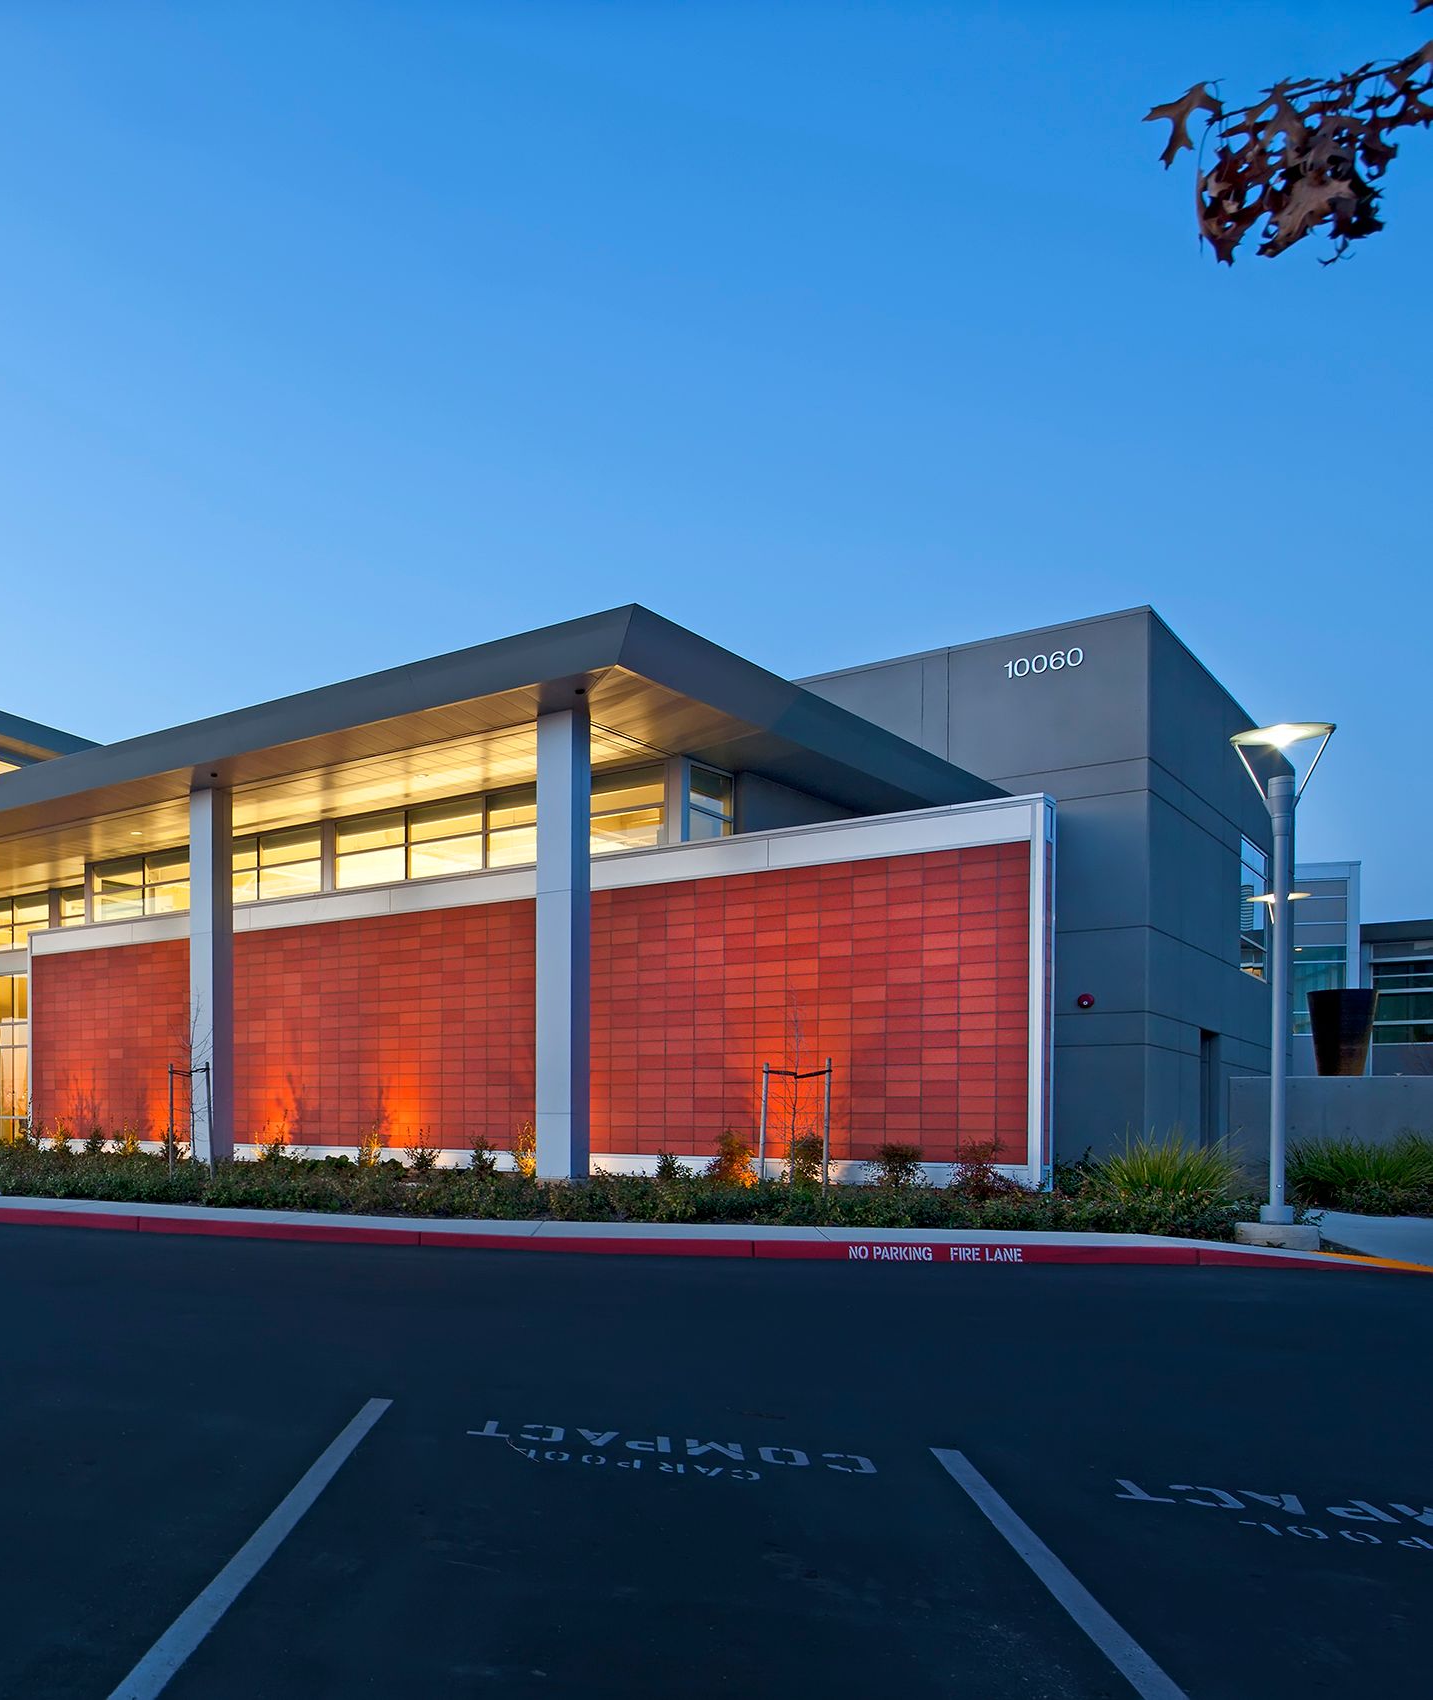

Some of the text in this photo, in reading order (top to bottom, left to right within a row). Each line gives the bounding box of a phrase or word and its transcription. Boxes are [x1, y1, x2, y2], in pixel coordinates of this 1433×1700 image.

[1003, 647, 1084, 679] 10060
[848, 1245, 1023, 1263] NO PARKING FIRE LANE
[466, 1420, 878, 1474] COMPACT
